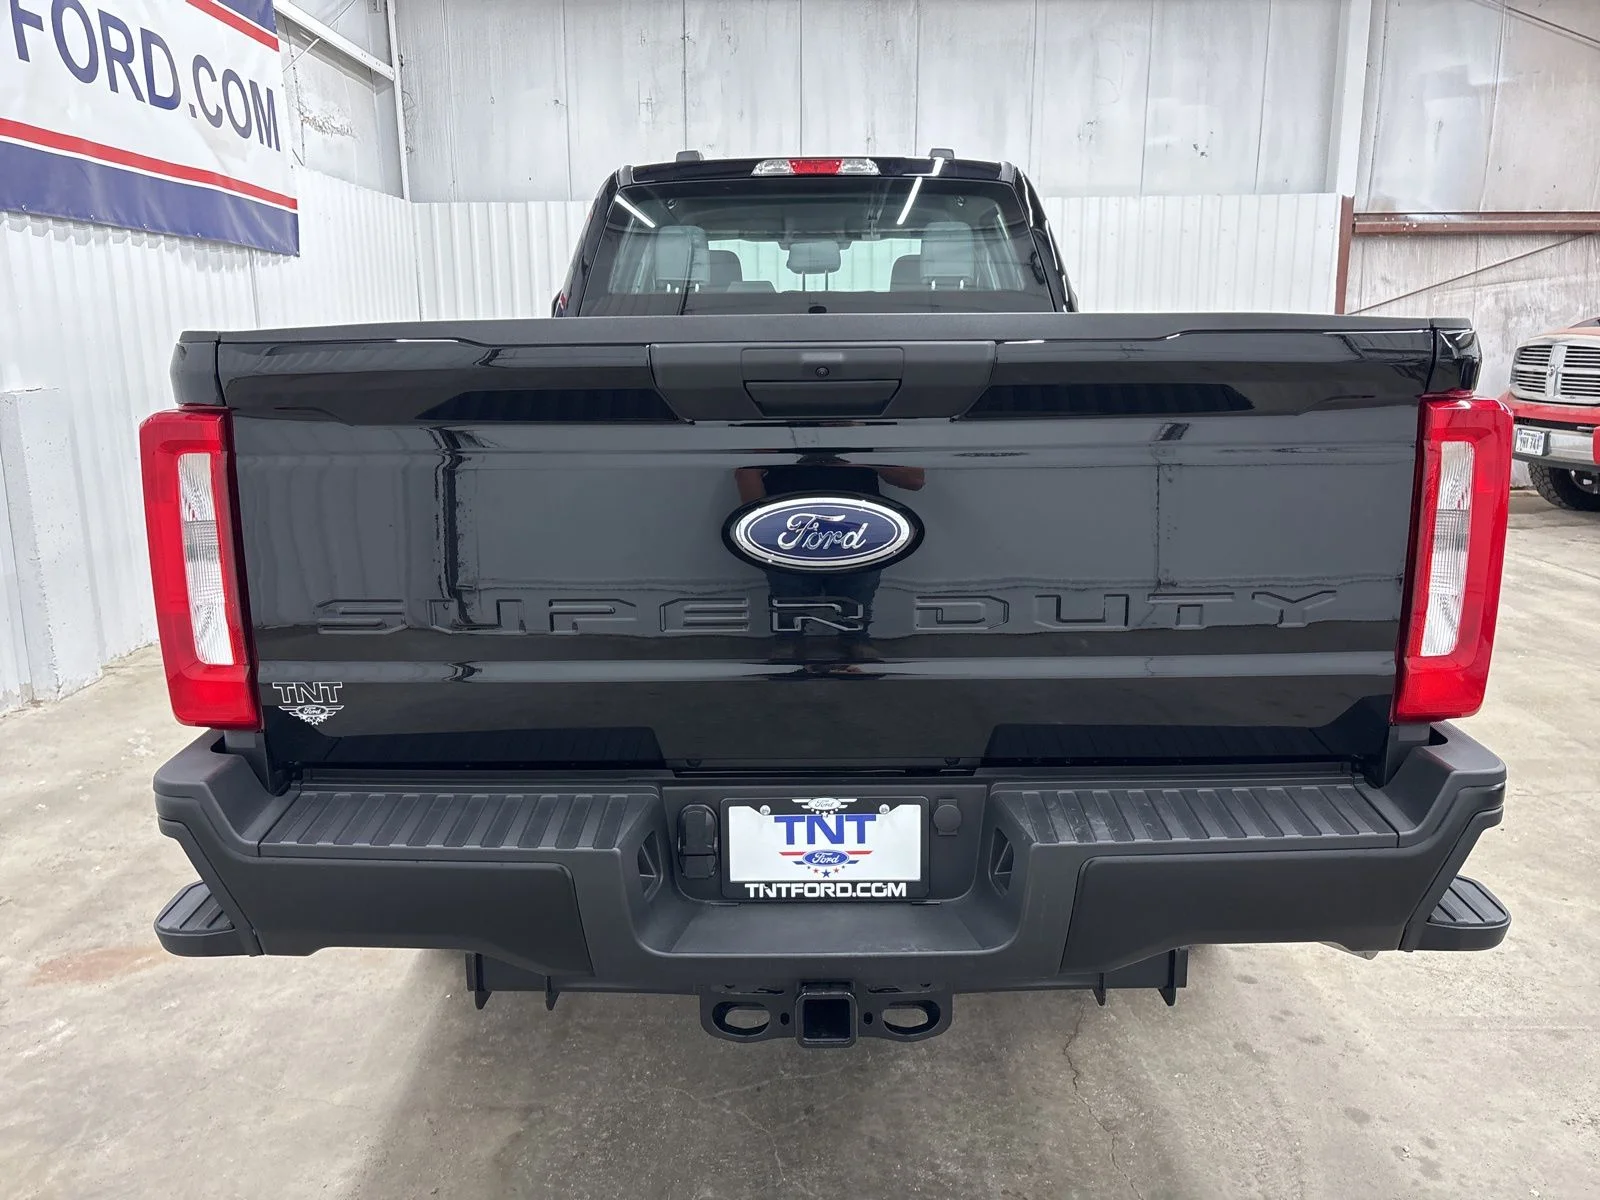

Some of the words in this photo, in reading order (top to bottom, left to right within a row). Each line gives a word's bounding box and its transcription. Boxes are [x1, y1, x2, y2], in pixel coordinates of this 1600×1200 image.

[10, 0, 281, 152] FORD.COM
[777, 512, 869, 550] Ford
[315, 598, 867, 637] SUPER
[914, 590, 1338, 631] DUTY
[272, 682, 343, 703] TNT
[774, 815, 877, 845] TNT
[811, 853, 840, 864] Ford
[744, 882, 907, 898] TNTFORD.COM
